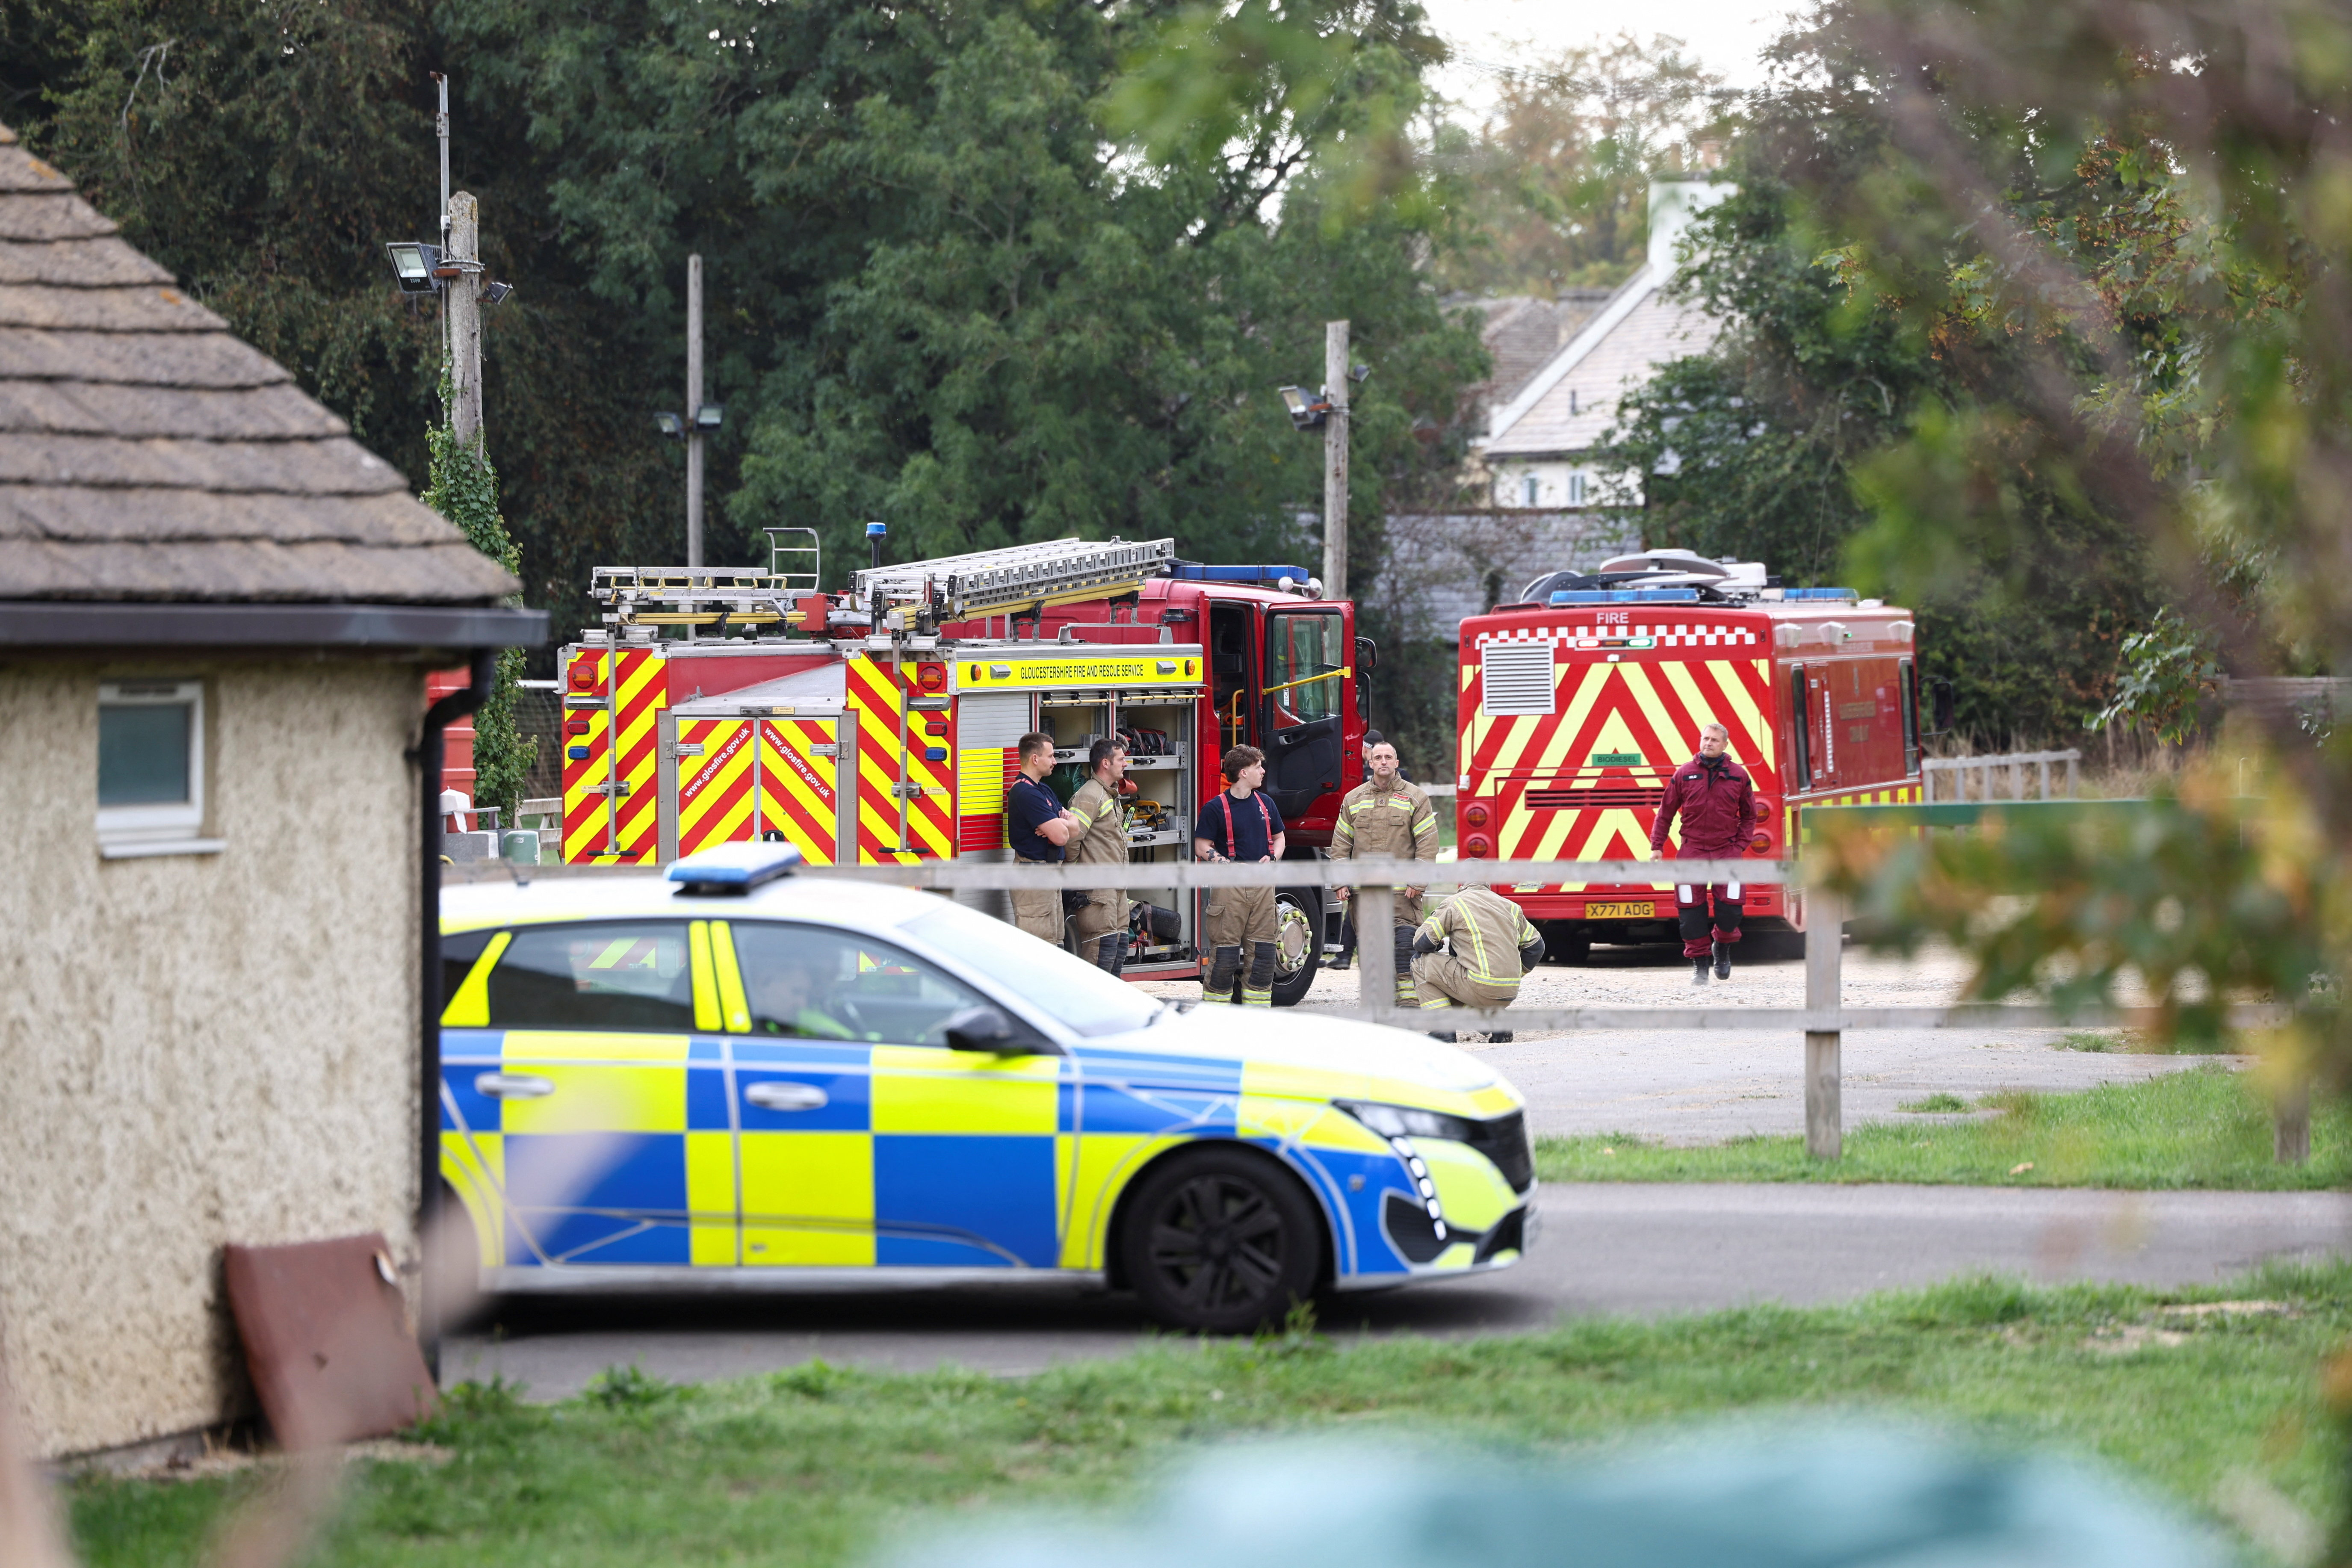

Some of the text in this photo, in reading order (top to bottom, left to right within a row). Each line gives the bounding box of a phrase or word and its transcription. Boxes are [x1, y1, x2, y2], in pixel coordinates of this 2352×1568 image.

[1597, 612, 1629, 624] FIRE
[1021, 664, 1143, 679] GLOUCESTERSHIRE FIRE AND RESCUE SERVICE
[685, 727, 750, 797] www.glosfire.gov.uk
[765, 727, 830, 798] www.glosfire.gov.uk
[1590, 904, 1650, 916] X771 ADG
